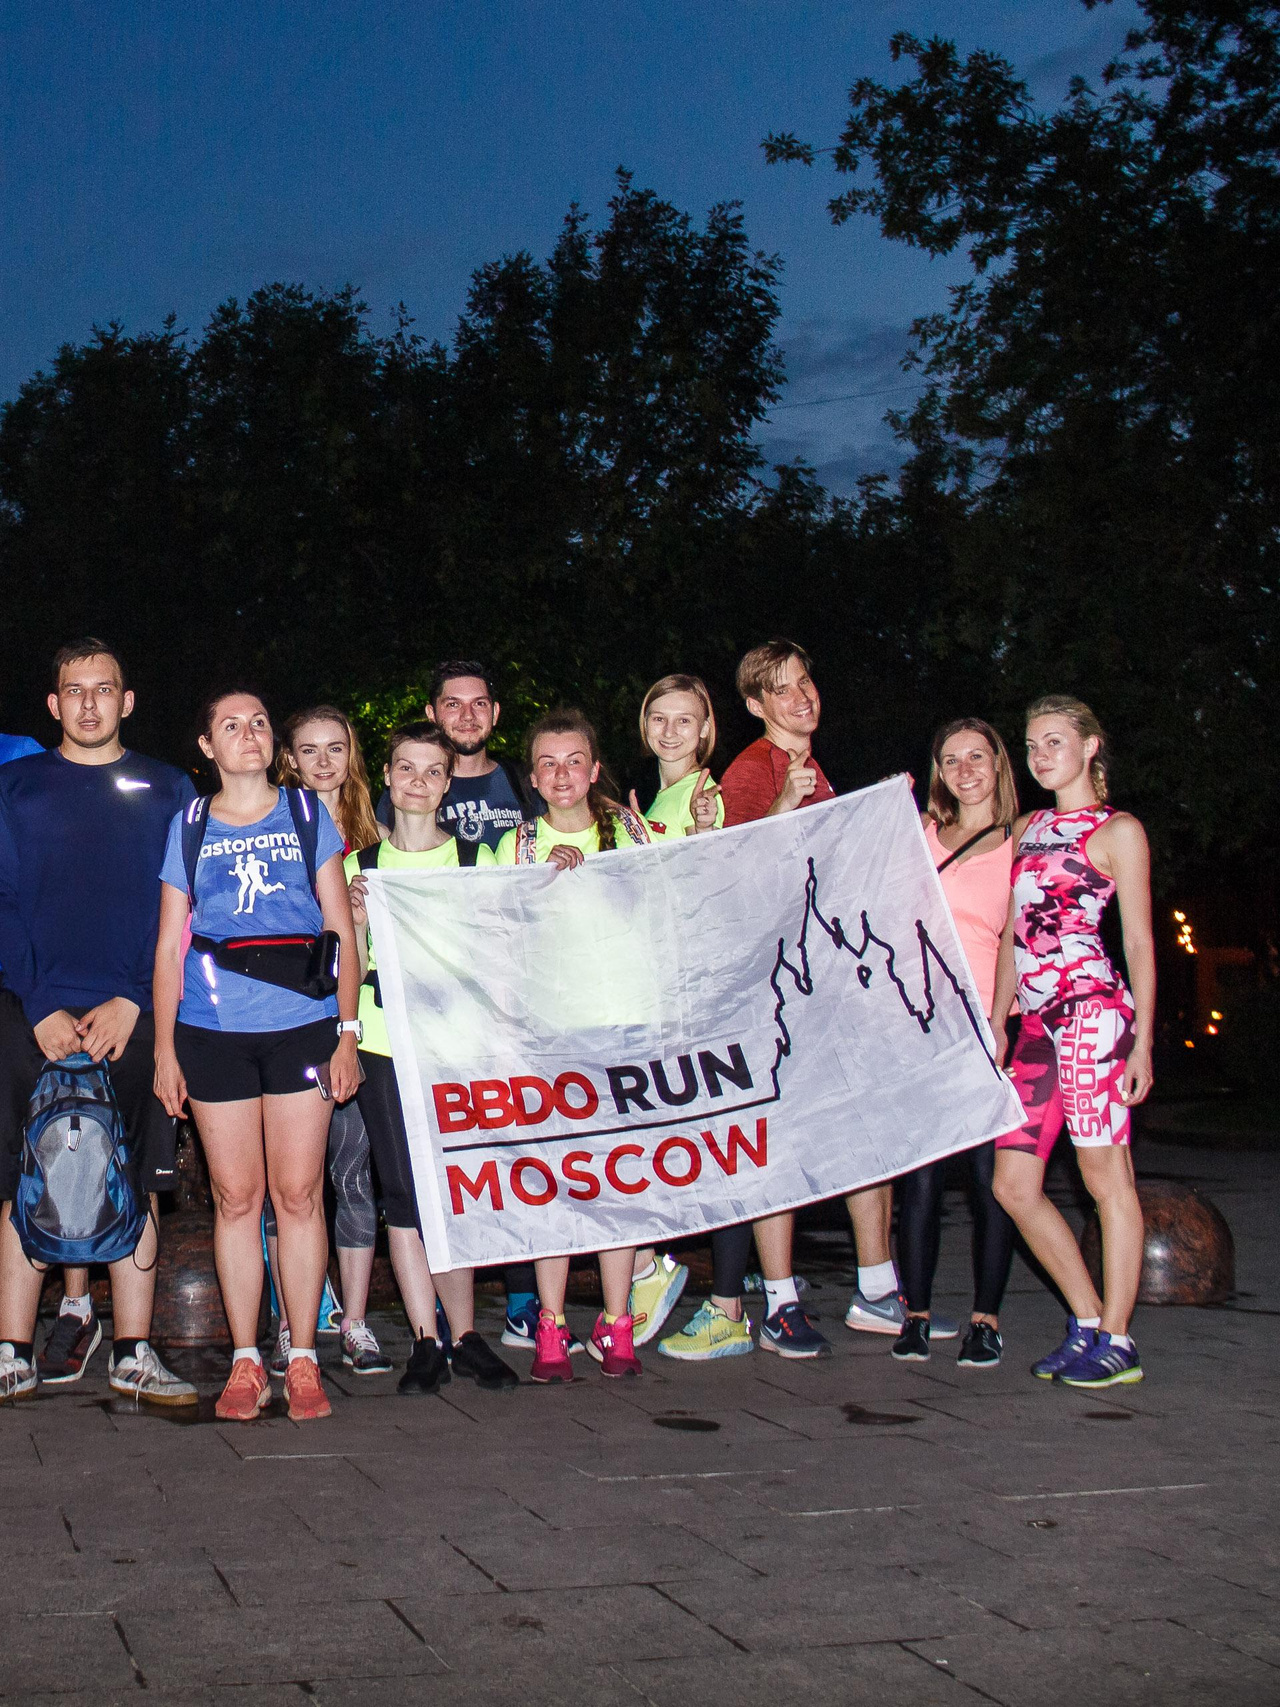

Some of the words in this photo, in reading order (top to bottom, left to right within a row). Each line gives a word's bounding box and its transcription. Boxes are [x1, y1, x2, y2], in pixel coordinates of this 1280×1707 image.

[199, 832, 301, 859] astorama
[270, 847, 303, 863] run
[431, 1071, 599, 1134] BBDO
[605, 1042, 754, 1115] RUN
[1074, 999, 1104, 1138] SPORTS
[445, 1117, 768, 1216] MOSCOW
